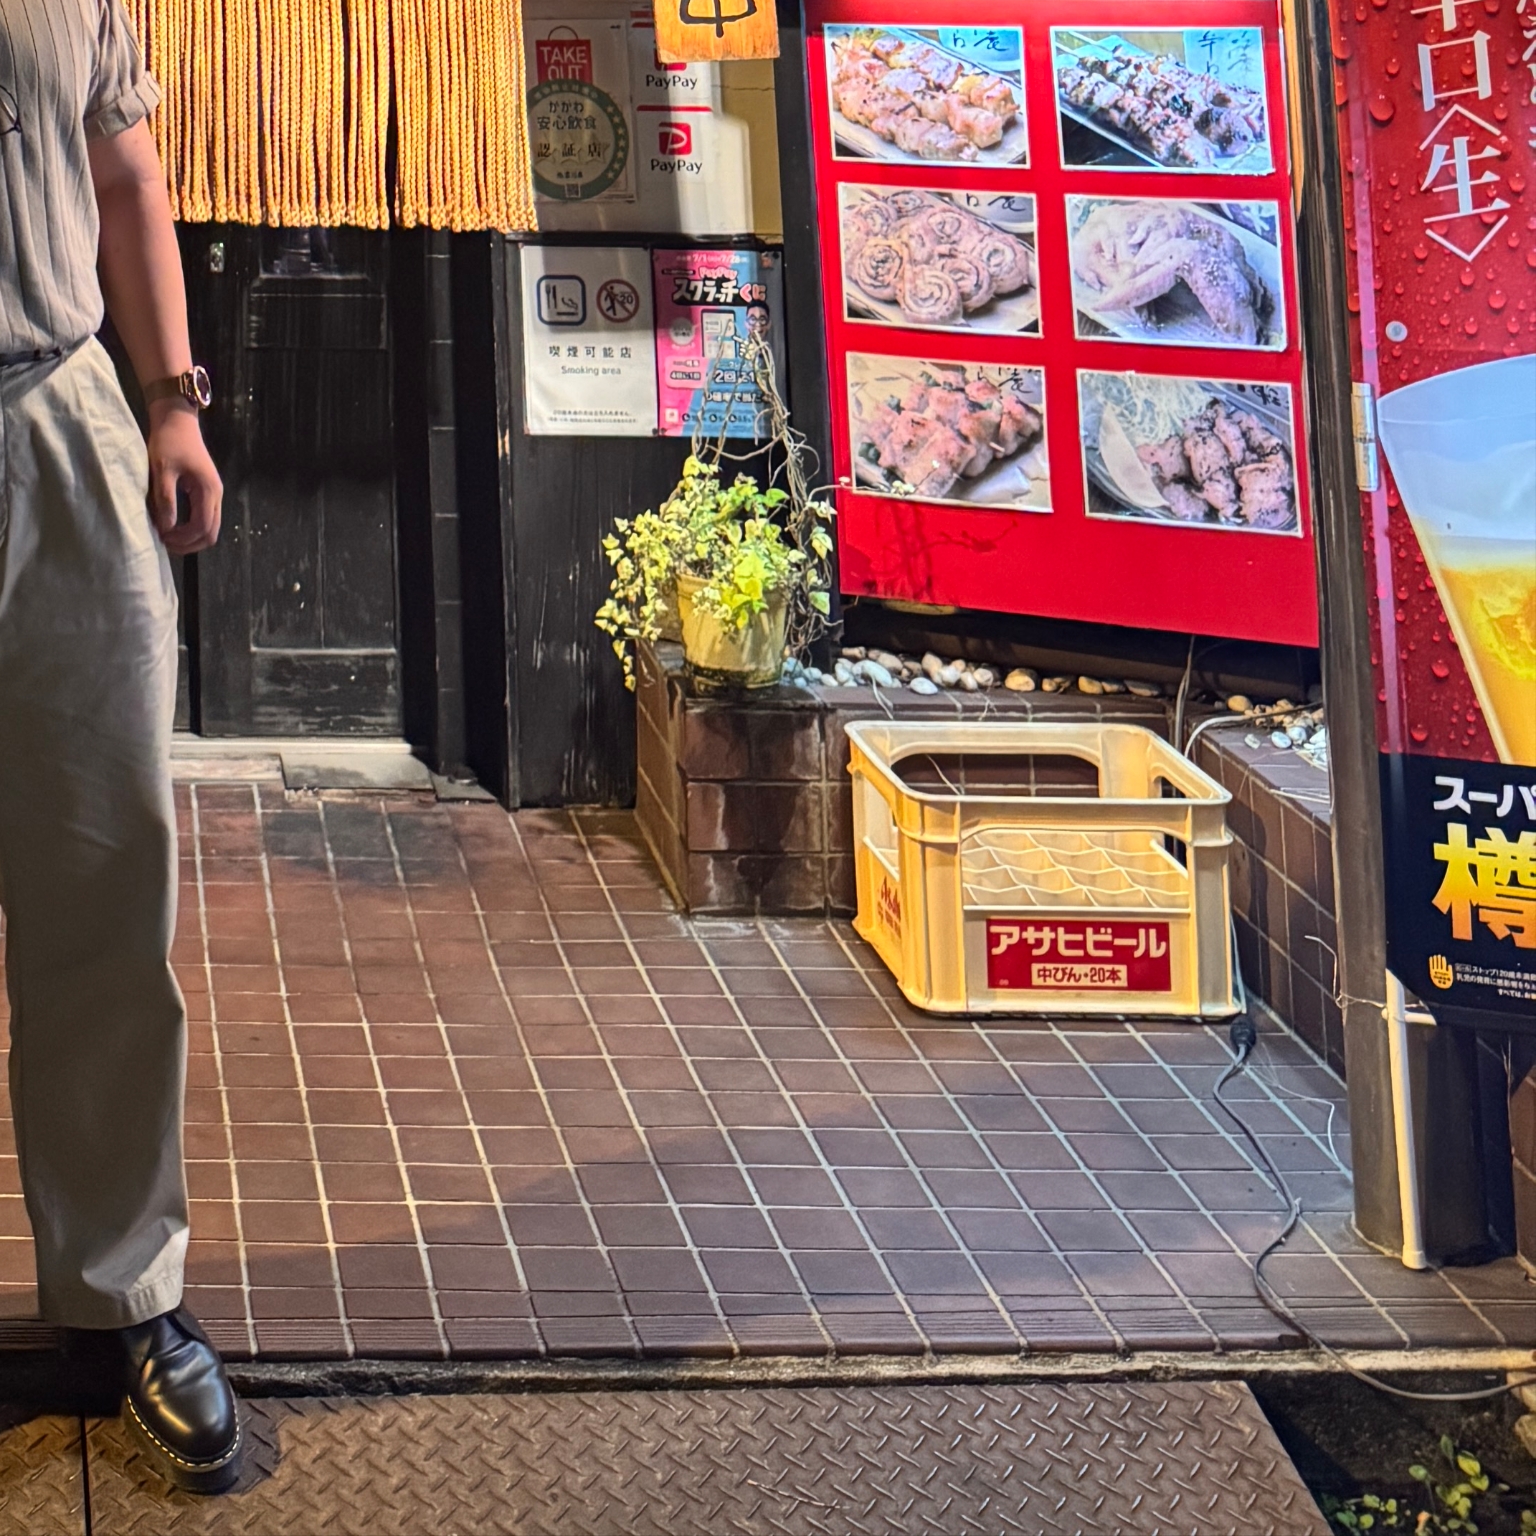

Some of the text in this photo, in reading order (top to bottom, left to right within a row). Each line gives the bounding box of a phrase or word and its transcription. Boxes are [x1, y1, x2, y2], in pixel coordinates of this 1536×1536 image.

[540, 46, 588, 64] TAKE
[645, 74, 698, 90] PayPay
[537, 114, 597, 131] 安心飲食
[650, 158, 703, 174] PayPay
[548, 345, 632, 359] 喫煙可能店
[561, 365, 622, 377] Smoking area
[989, 925, 1167, 959] アサヒビール
